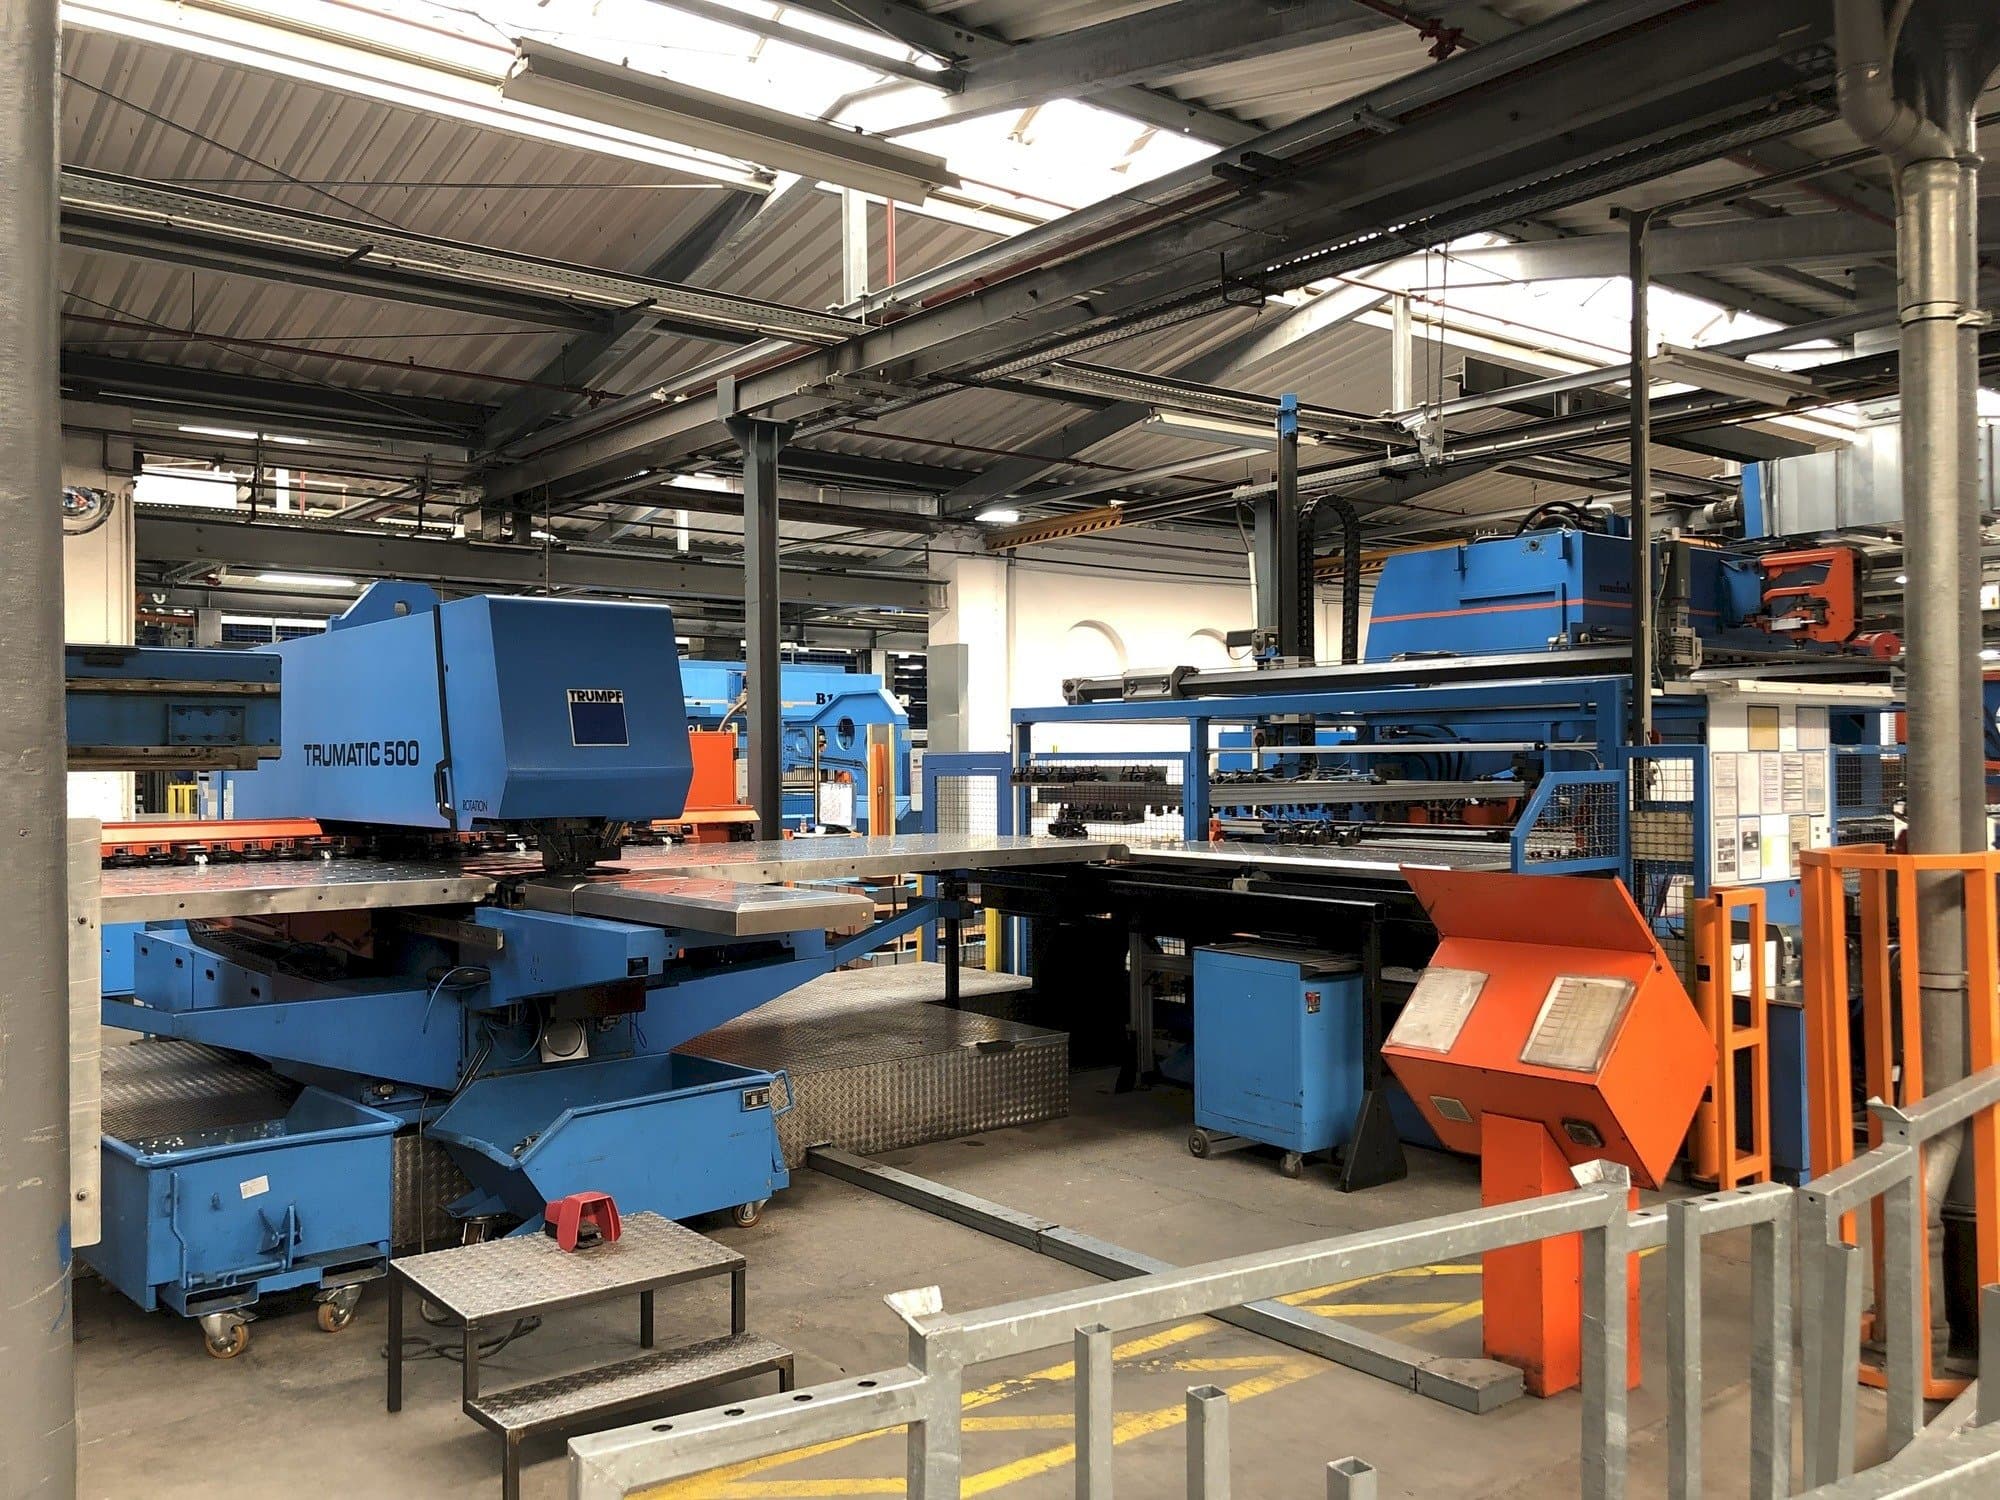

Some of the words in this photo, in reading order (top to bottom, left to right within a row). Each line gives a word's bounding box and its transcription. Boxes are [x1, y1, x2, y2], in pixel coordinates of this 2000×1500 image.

[568, 690, 623, 702] TRUMPF
[304, 742, 381, 767] TRUMATIC
[384, 740, 419, 766] 500
